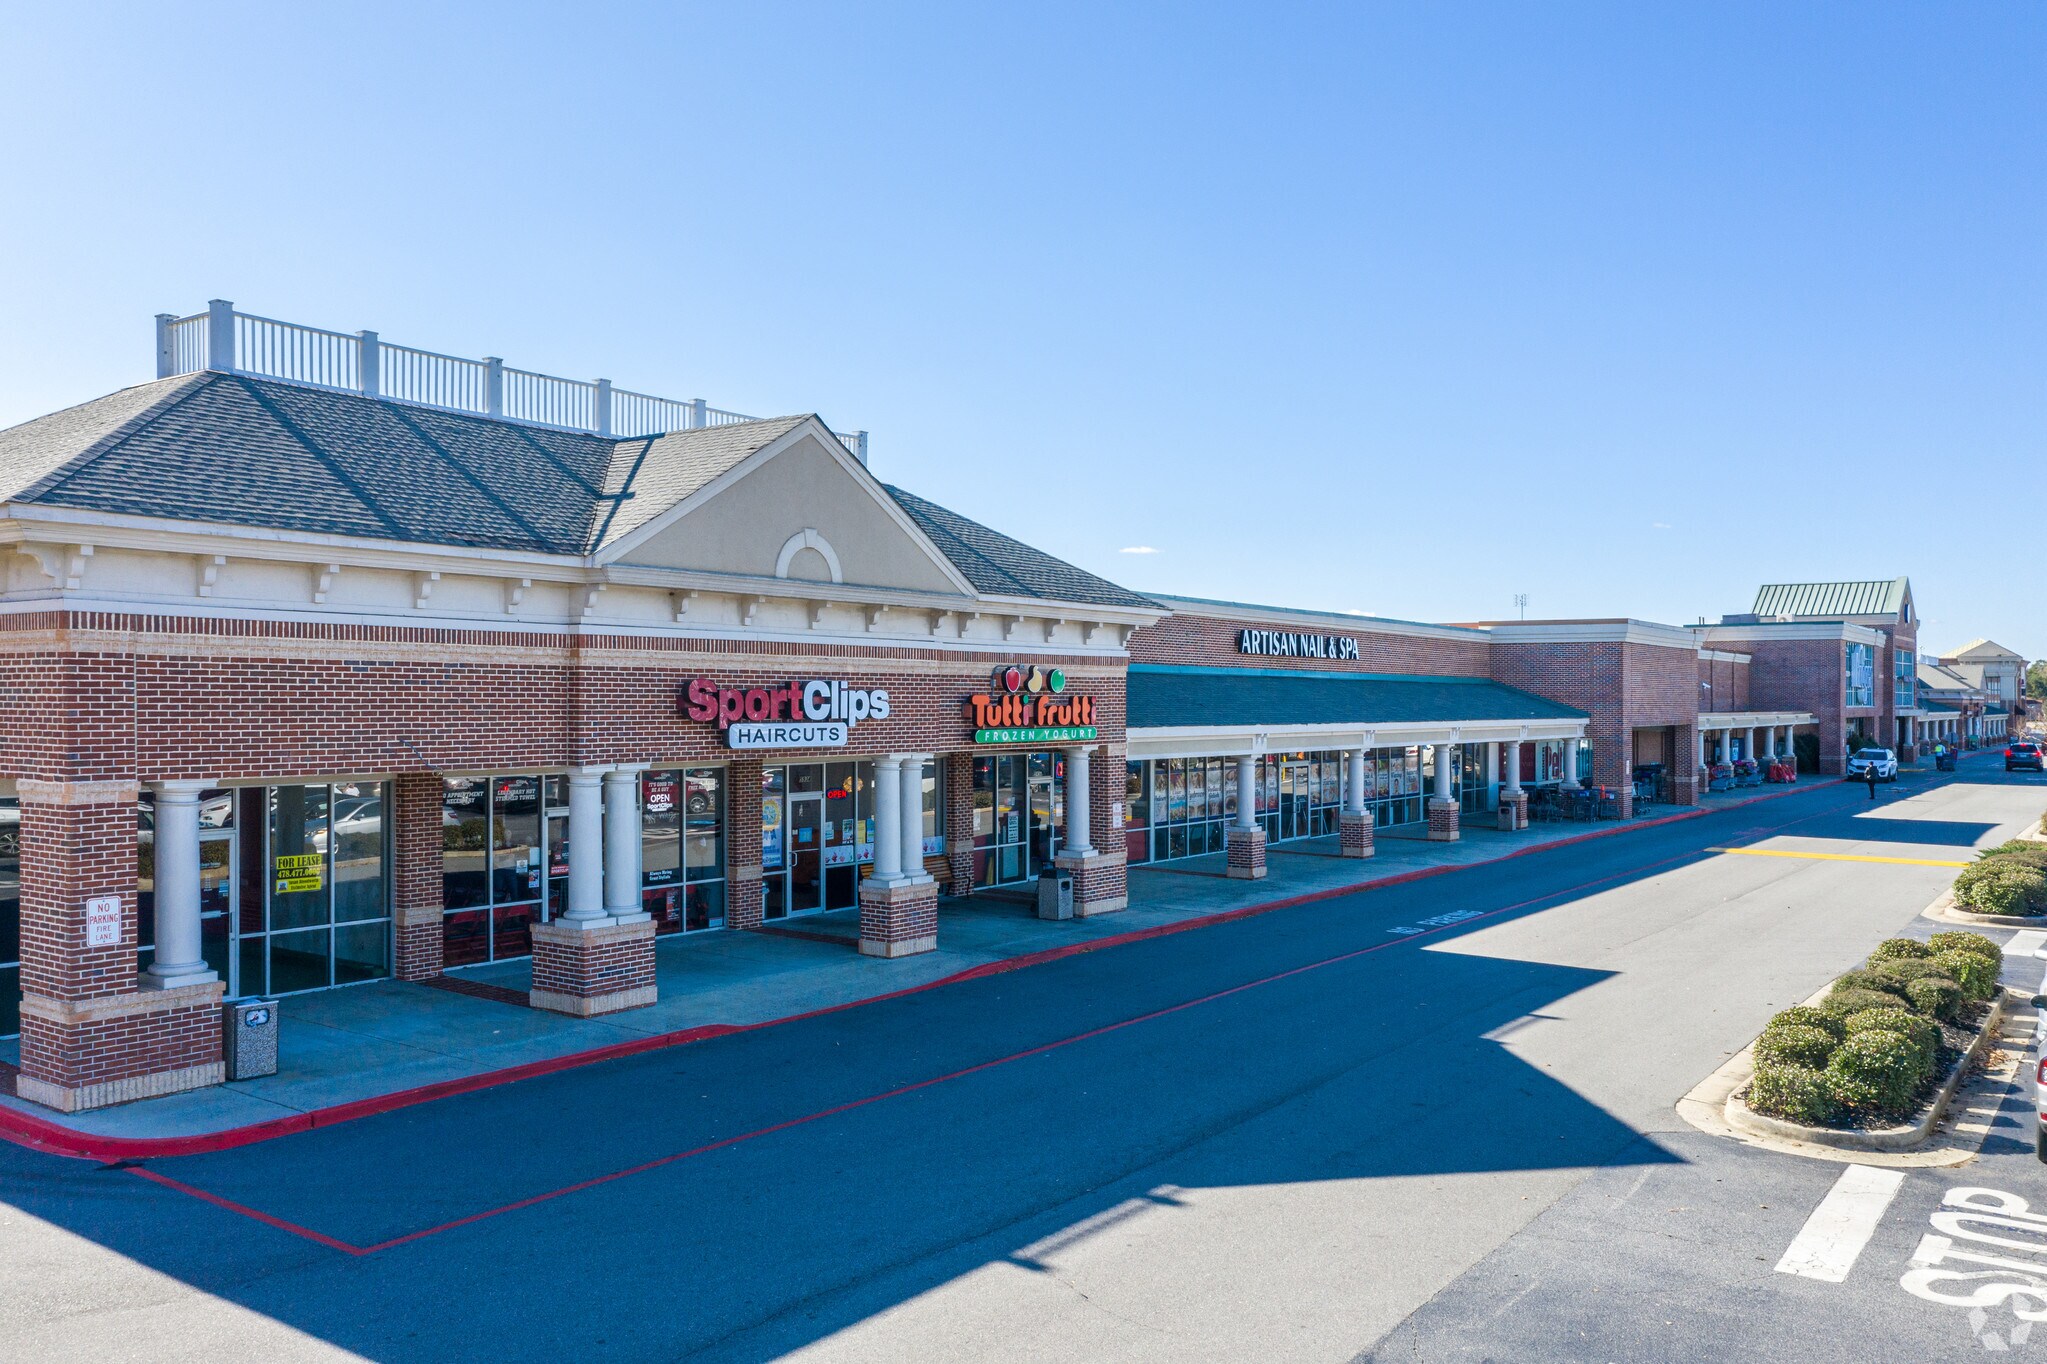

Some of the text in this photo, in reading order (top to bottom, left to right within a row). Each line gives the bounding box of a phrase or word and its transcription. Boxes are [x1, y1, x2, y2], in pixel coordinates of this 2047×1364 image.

[1241, 629, 1359, 660] ARTISAN NAIL & SPA
[687, 678, 891, 730] SportClips
[971, 694, 1031, 727] Tutti
[738, 727, 840, 744] HAIRCUTS
[984, 729, 1093, 741] FROZEN YOGURT
[497, 788, 526, 796] LEDARY
[650, 793, 670, 803] OPEN
[827, 790, 847, 799] OPEN
[277, 855, 321, 868] FOR LEASE
[97, 903, 110, 913] NO
[89, 913, 119, 925] PARKING
[96, 925, 112, 933] FIRE
[95, 933, 113, 941] LANE
[1900, 1187, 2047, 1322] STOP
